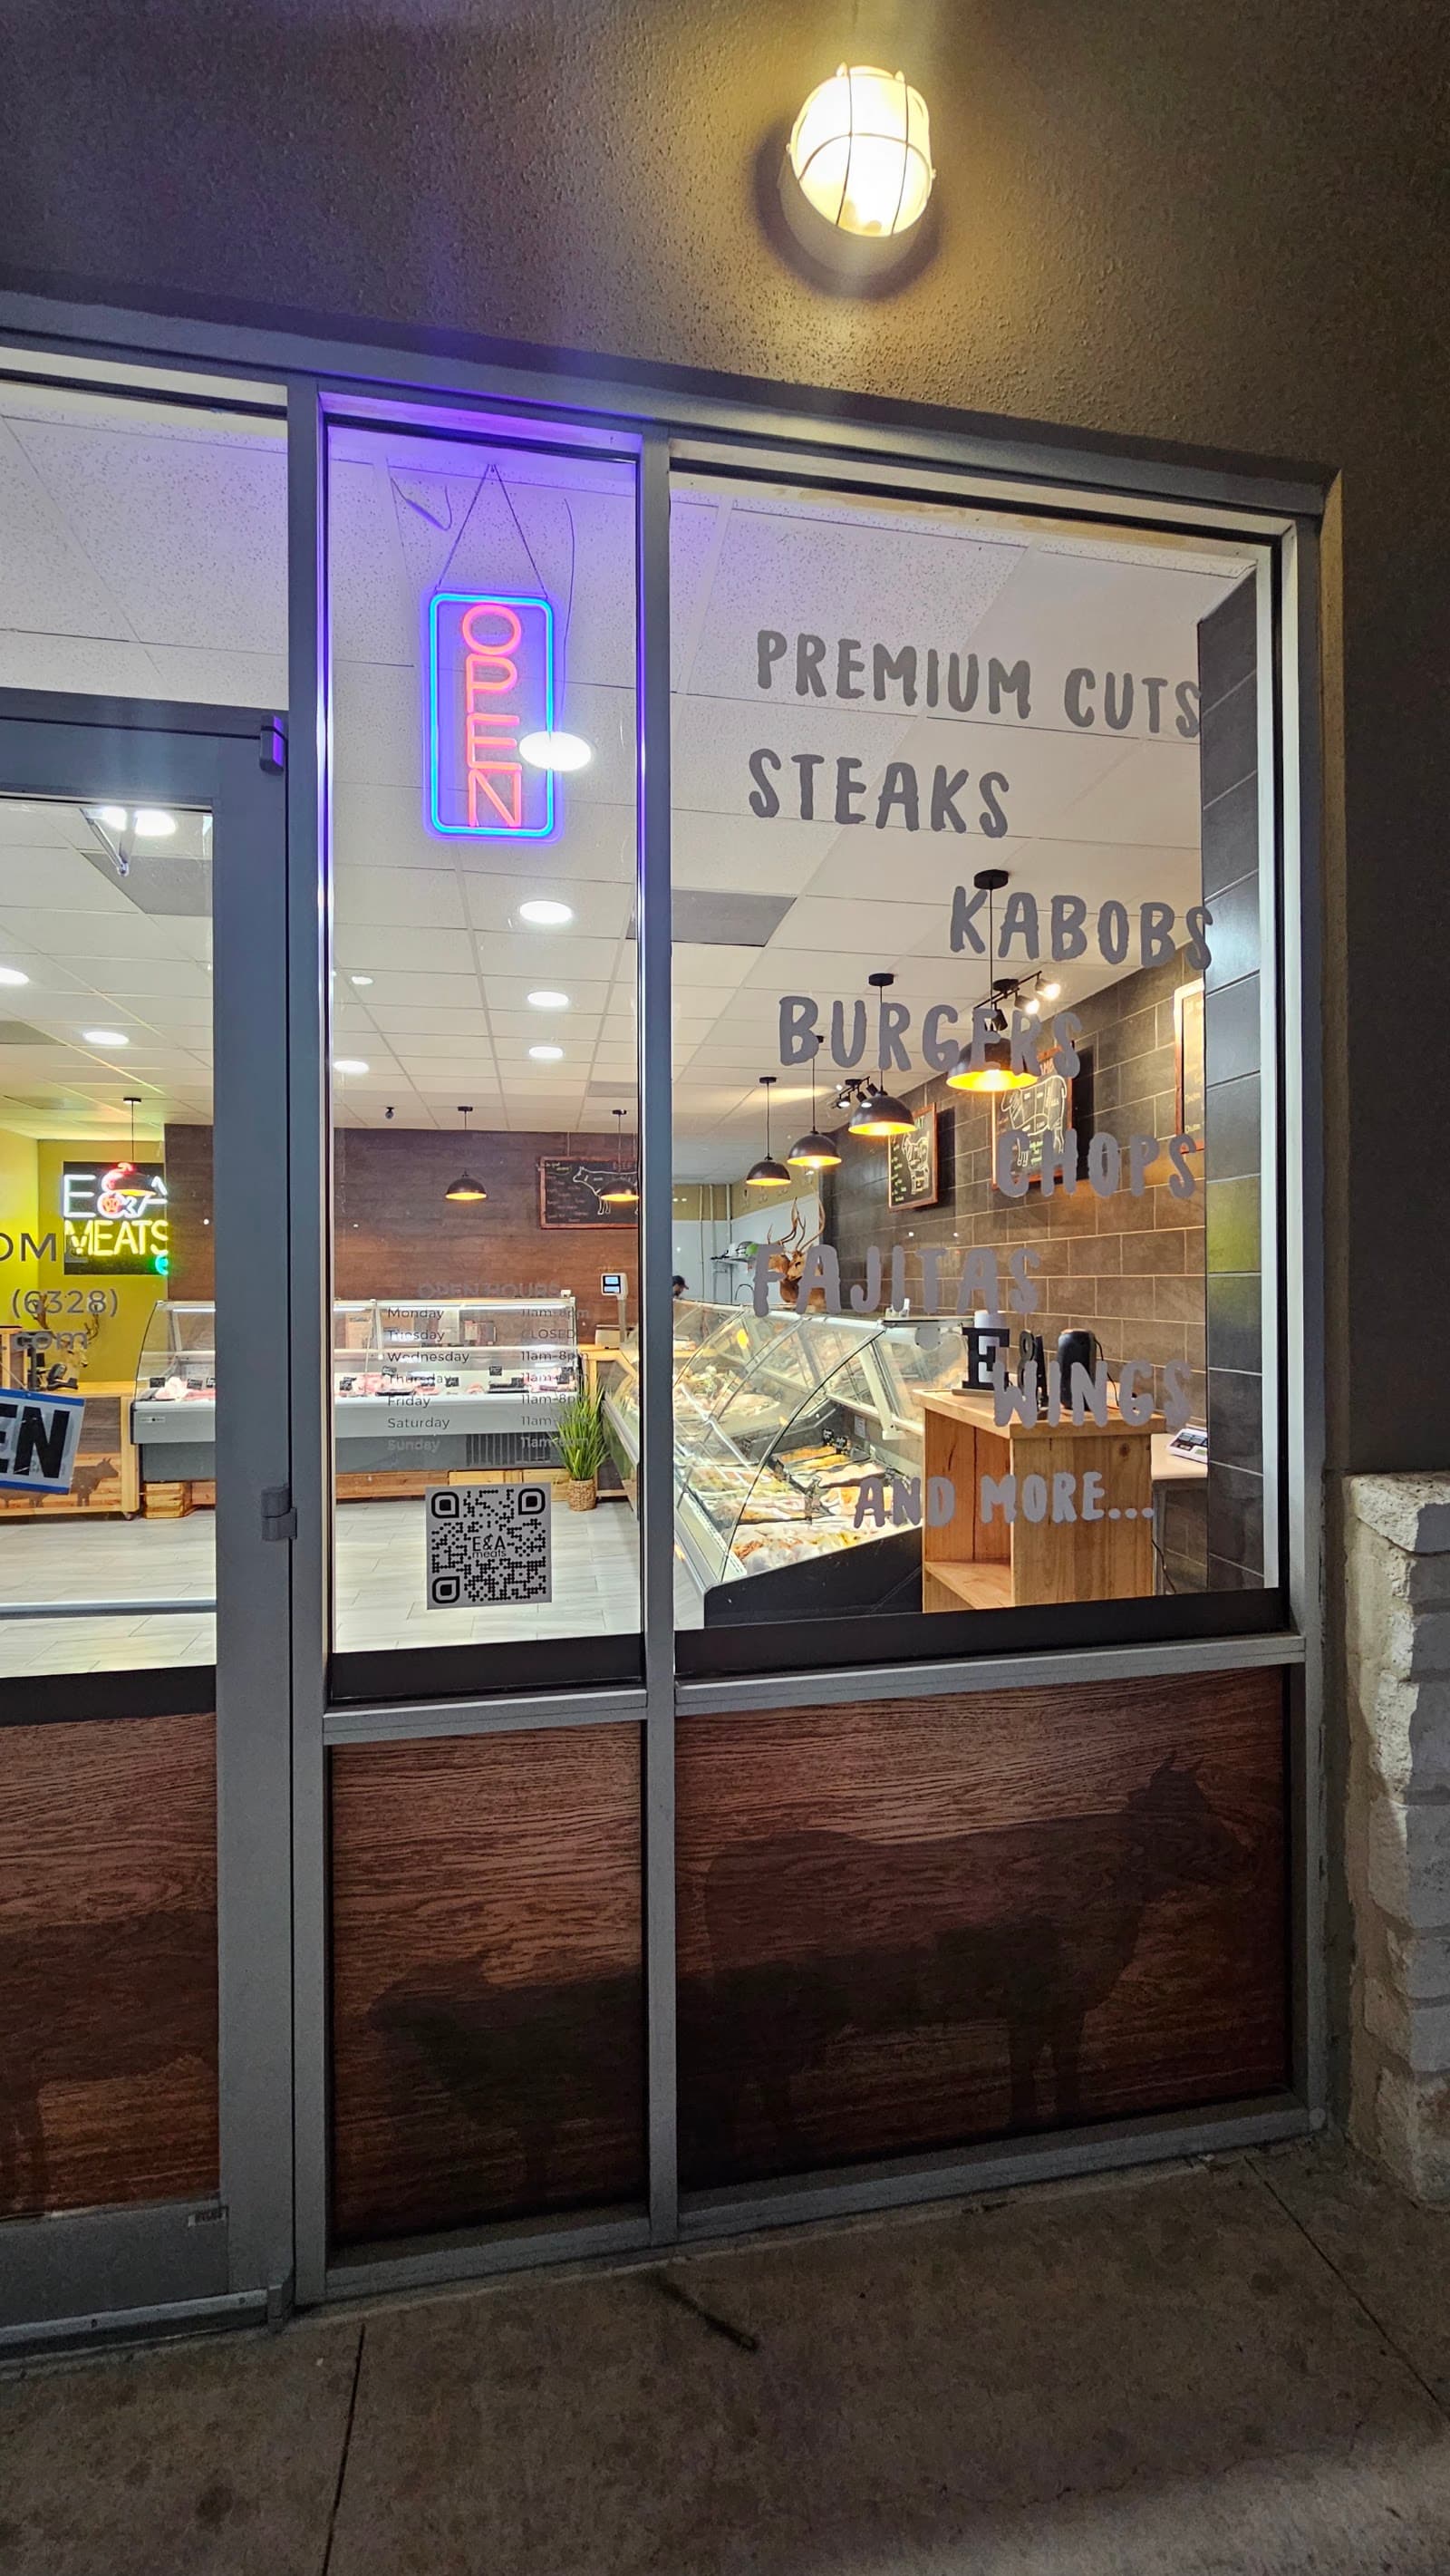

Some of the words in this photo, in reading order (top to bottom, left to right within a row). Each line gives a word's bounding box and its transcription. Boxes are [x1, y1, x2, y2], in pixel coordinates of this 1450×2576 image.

[756, 629, 1033, 721] PREMIUM
[1063, 666, 1204, 739] CUTS
[462, 603, 522, 828] OPEN
[748, 748, 1010, 838] STEAKS
[949, 885, 1214, 972] KABOBS
[778, 995, 1084, 1080] BURGERS
[998, 1128, 1197, 1198] CHOPS
[63, 1219, 169, 1256] MEATS
[753, 1243, 1041, 1318] FAJITAS
[13, 1288, 119, 1318] (6328)
[387, 1308, 445, 1320] Monday
[521, 1328, 575, 1340] CLOSED
[387, 1350, 470, 1363] Wednesday
[521, 1351, 589, 1363] 11am-8pm
[387, 1394, 430, 1409] Friday
[993, 1360, 1194, 1429] WINGS
[387, 1417, 450, 1429] Saturday
[387, 1438, 440, 1453] Sunday
[854, 1477, 956, 1529] AND
[980, 1471, 1155, 1525] MORE...
[472, 1534, 506, 1551] E&A
[472, 1548, 507, 1558] meats
